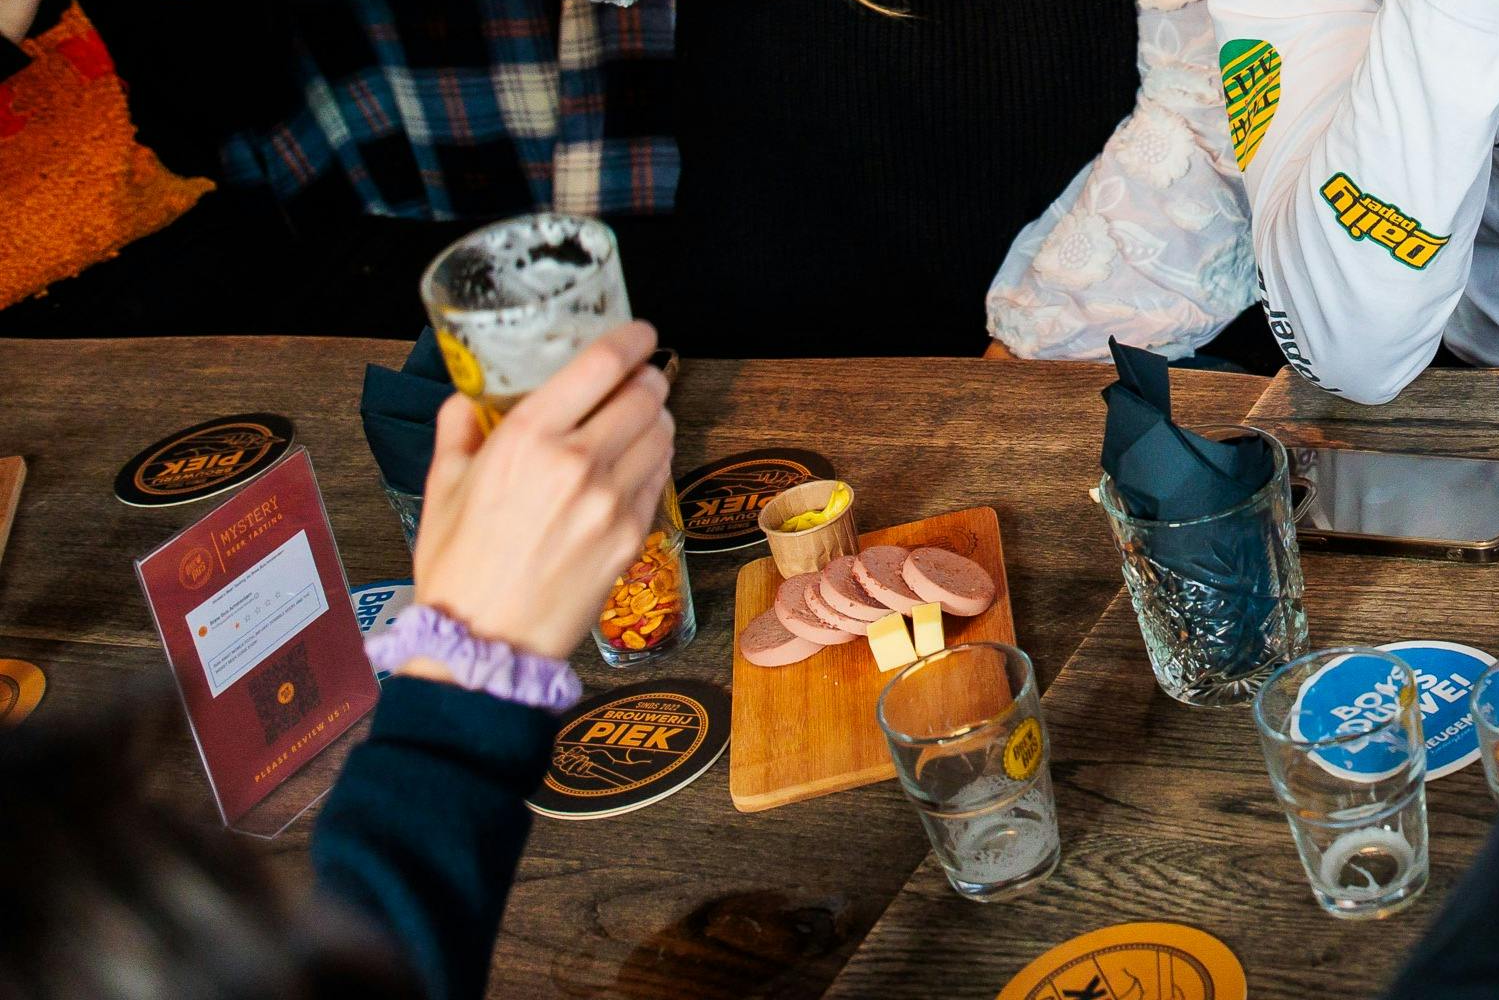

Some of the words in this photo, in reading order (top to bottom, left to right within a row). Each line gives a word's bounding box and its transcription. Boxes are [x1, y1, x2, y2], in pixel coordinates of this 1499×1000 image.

[1323, 176, 1450, 269] Daily
[1361, 198, 1416, 231] paper
[157, 450, 244, 475] PIEK
[220, 495, 279, 545] MYSTERY
[249, 513, 283, 541] TASTING
[688, 512, 757, 527] OUWERIJ
[603, 710, 692, 724] BROUWERIJ
[635, 701, 659, 710] SINDS
[659, 703, 681, 711] 2022
[255, 752, 289, 782] PLEASE
[291, 721, 326, 753] REVIEW
[327, 710, 340, 722] US
[580, 722, 684, 749] PIEK
